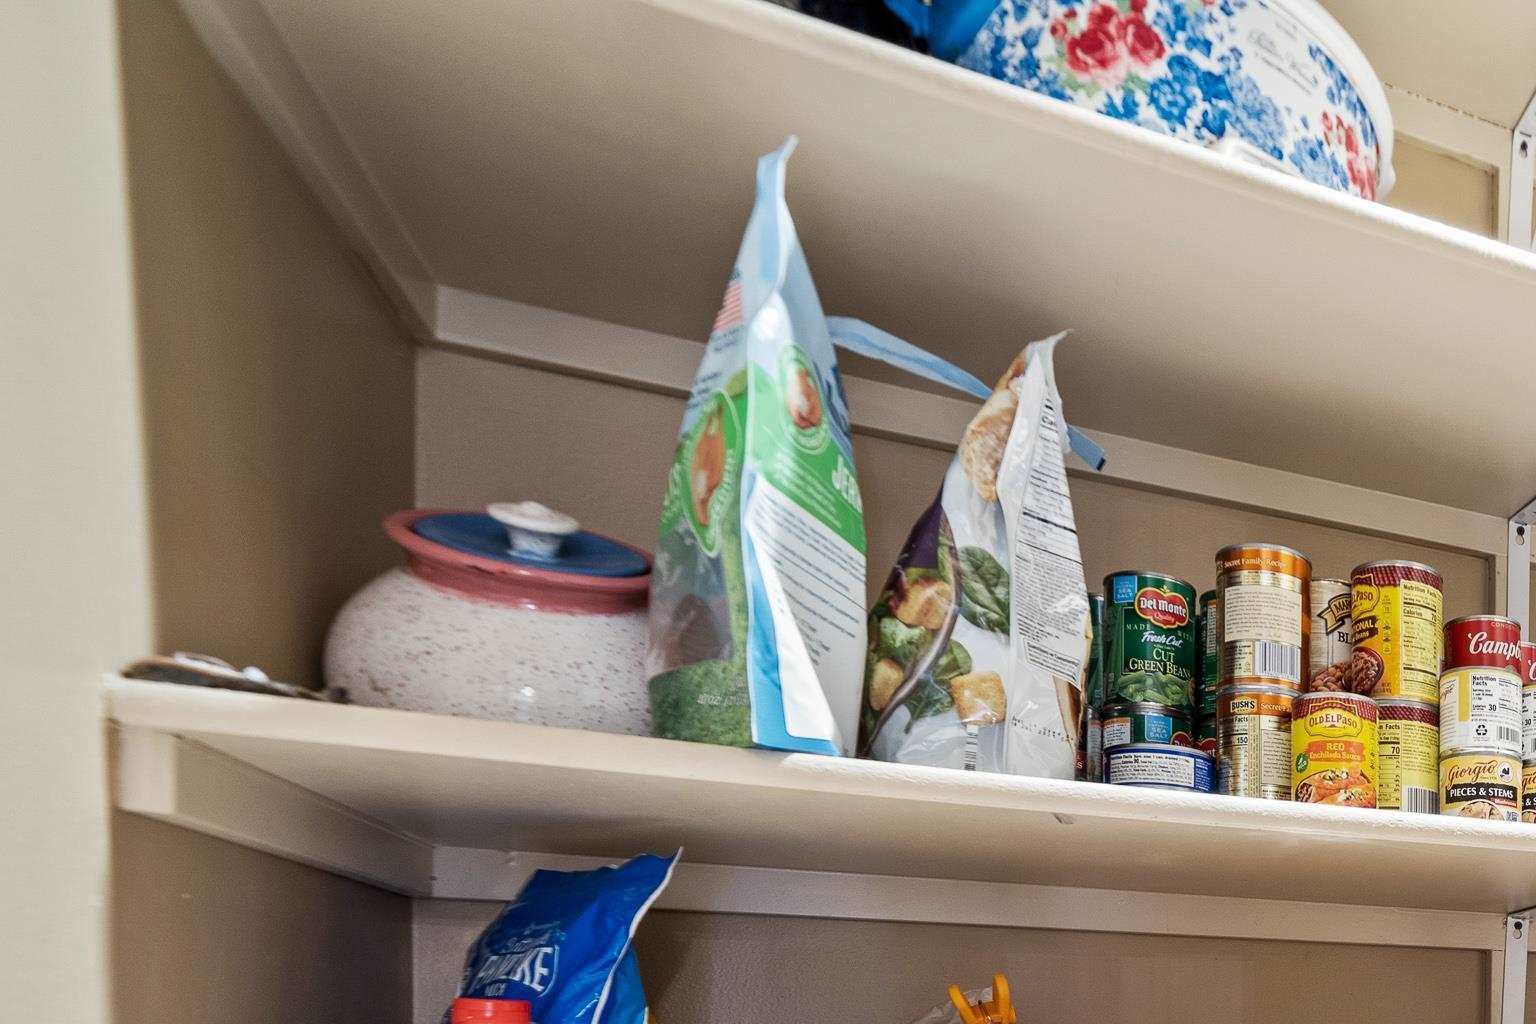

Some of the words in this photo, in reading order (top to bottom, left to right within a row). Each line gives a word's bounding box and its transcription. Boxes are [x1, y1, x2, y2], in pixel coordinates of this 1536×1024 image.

[1403, 584, 1425, 594] Nutrition
[1140, 597, 1157, 610] Del
[1158, 600, 1187, 617] Monte
[1403, 608, 1423, 617] Calories
[1126, 623, 1152, 632] MADE
[1141, 630, 1167, 643] Fresh
[1153, 647, 1175, 664] CUT
[1129, 657, 1164, 673] GREEN
[1232, 700, 1255, 711] BUSH'S
[1488, 704, 1497, 712] 30
[1309, 715, 1326, 728] OLD
[1325, 713, 1336, 723] EL
[1385, 723, 1400, 731] Facts
[1236, 736, 1249, 744] 150
[1326, 742, 1345, 751] RED
[1391, 746, 1400, 755] 70
[1310, 750, 1341, 760] Enchilada
[1447, 759, 1499, 790] Giorgio
[1450, 787, 1476, 798] PIECES
[1479, 787, 1486, 796] &
[1488, 787, 1514, 799] STEMS
